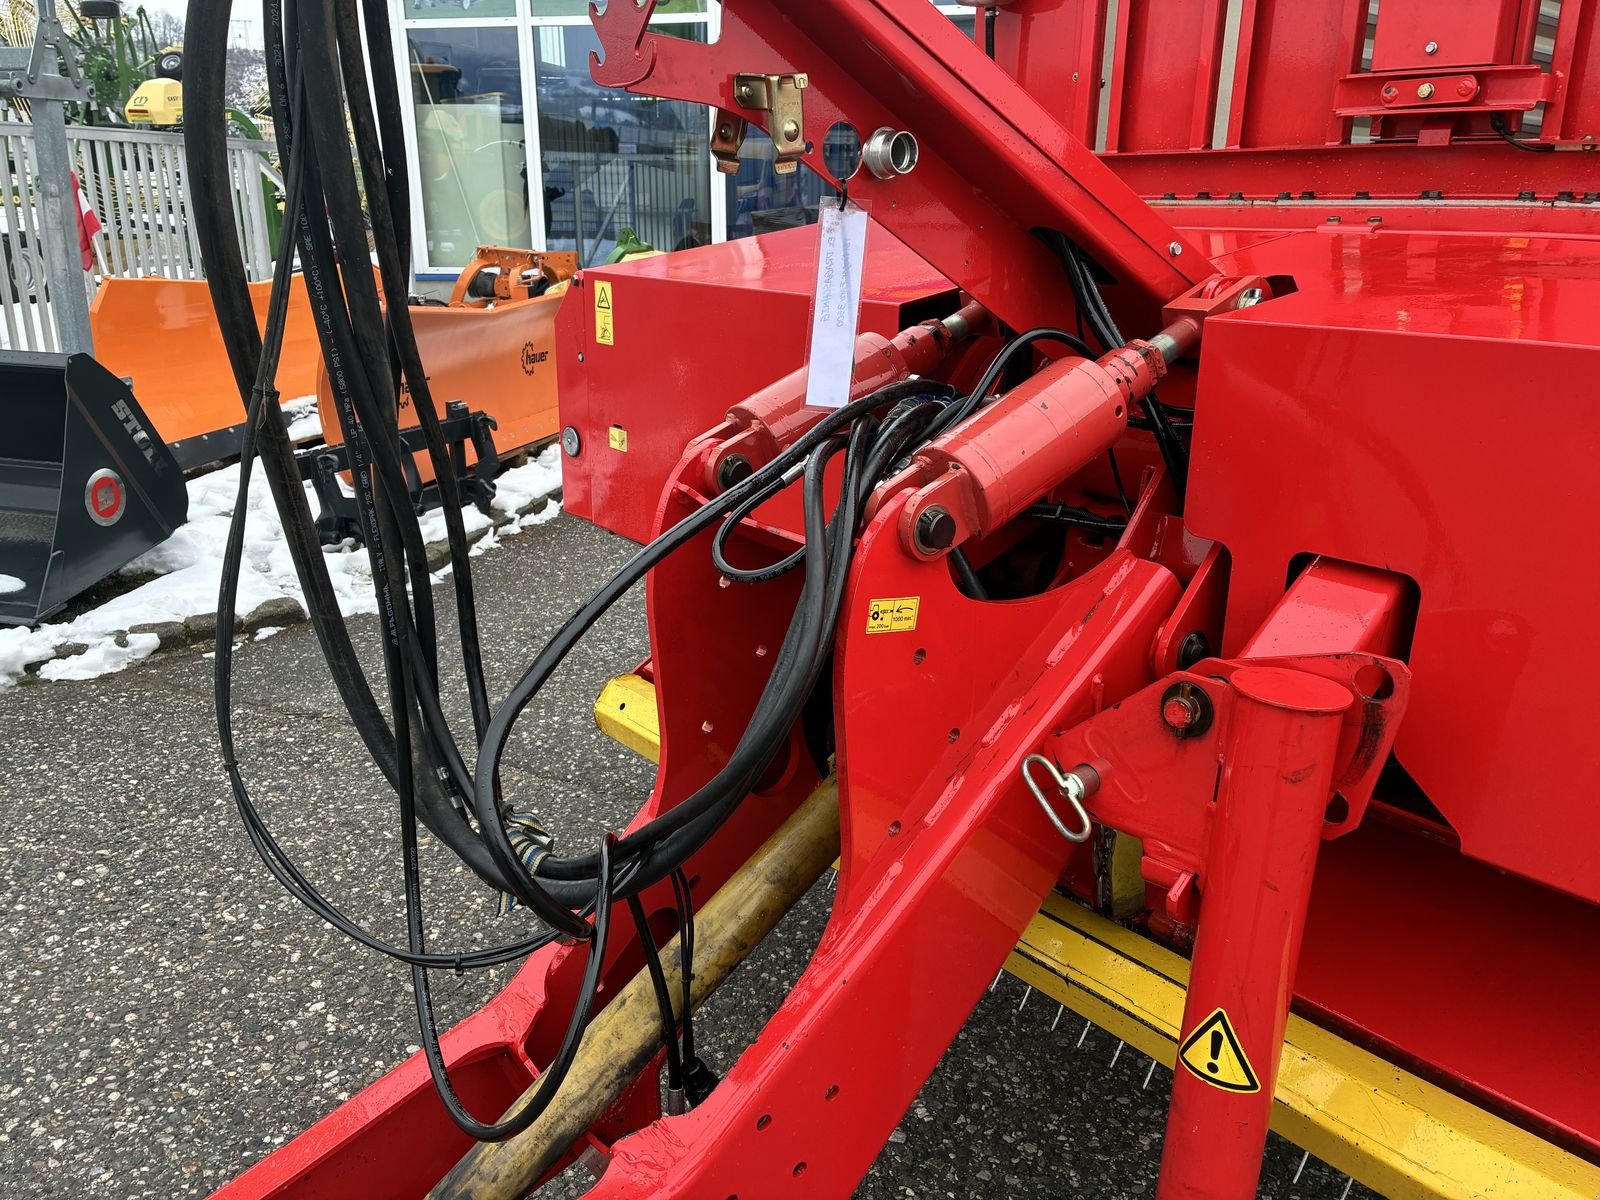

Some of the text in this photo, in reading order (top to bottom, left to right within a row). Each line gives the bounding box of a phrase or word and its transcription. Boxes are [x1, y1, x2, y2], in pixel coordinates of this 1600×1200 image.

[303, 235, 314, 251] SAE
[526, 350, 549, 365] hauer
[343, 398, 352, 413] MPa
[347, 414, 354, 425] 40
[111, 399, 165, 473] STOL
[376, 552, 387, 572] ITALY
